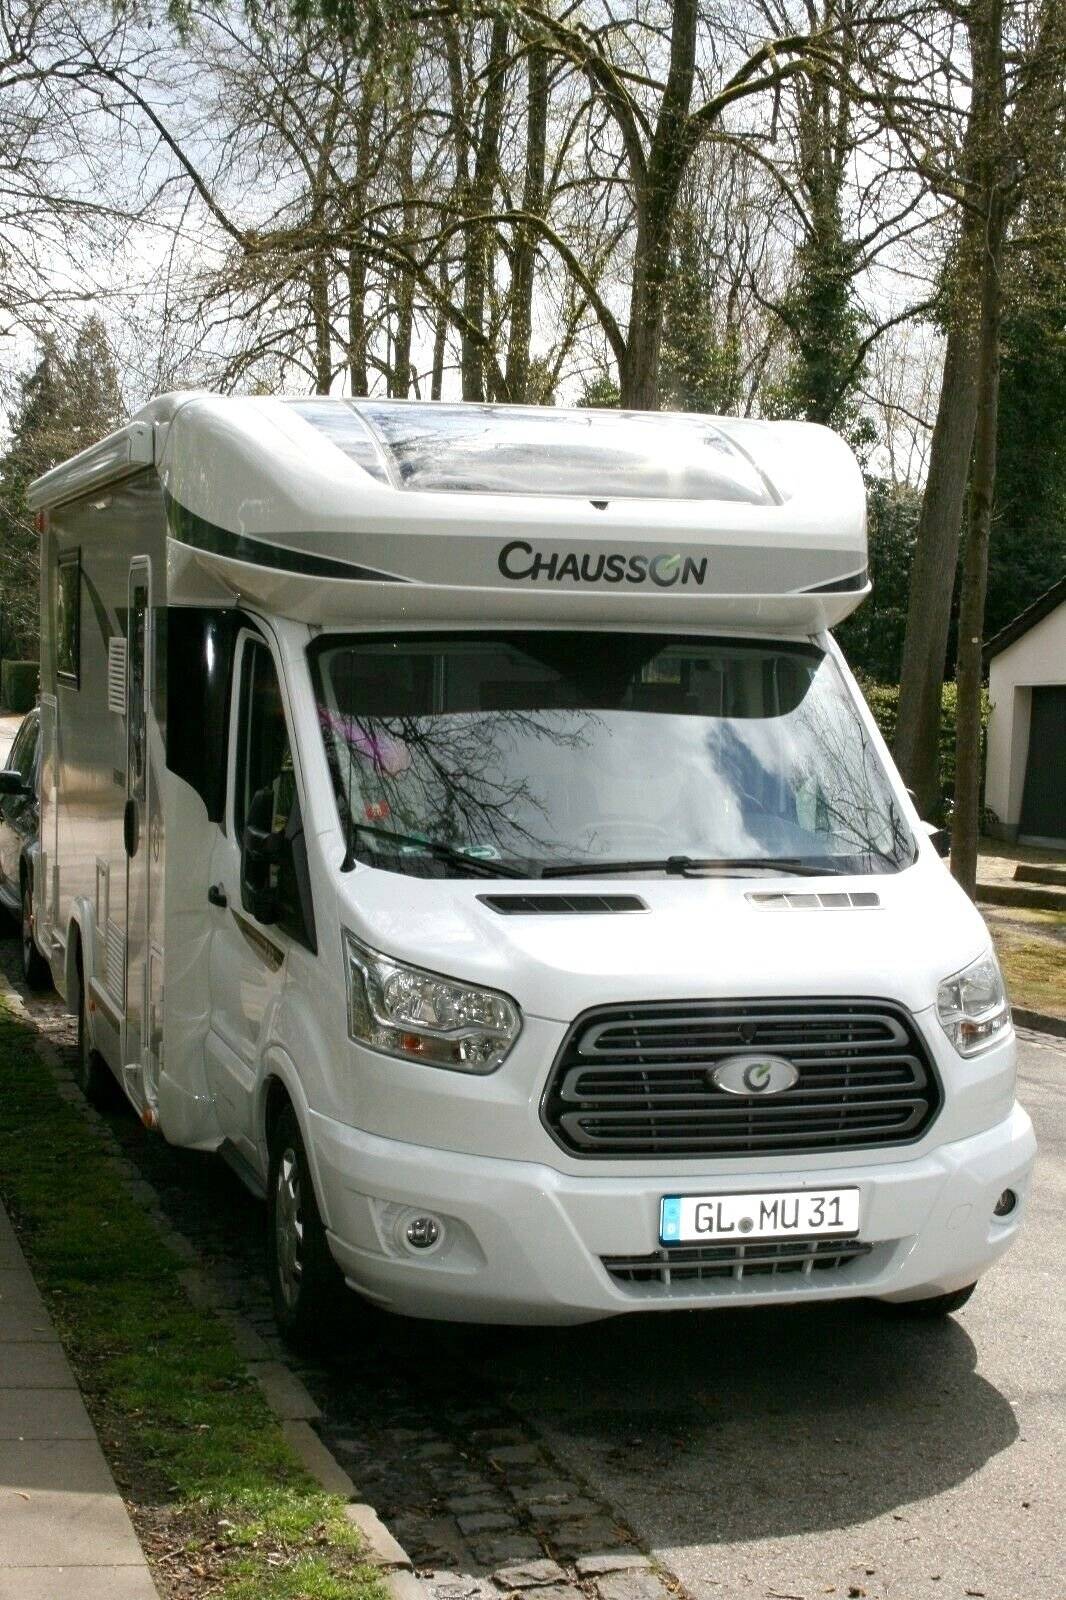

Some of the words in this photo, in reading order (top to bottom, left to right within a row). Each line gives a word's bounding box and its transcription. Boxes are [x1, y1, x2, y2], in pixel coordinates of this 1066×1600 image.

[498, 540, 708, 588] CHAUSSON
[694, 1202, 735, 1233] GL
[759, 1198, 800, 1230] MU
[807, 1196, 844, 1228] 31
